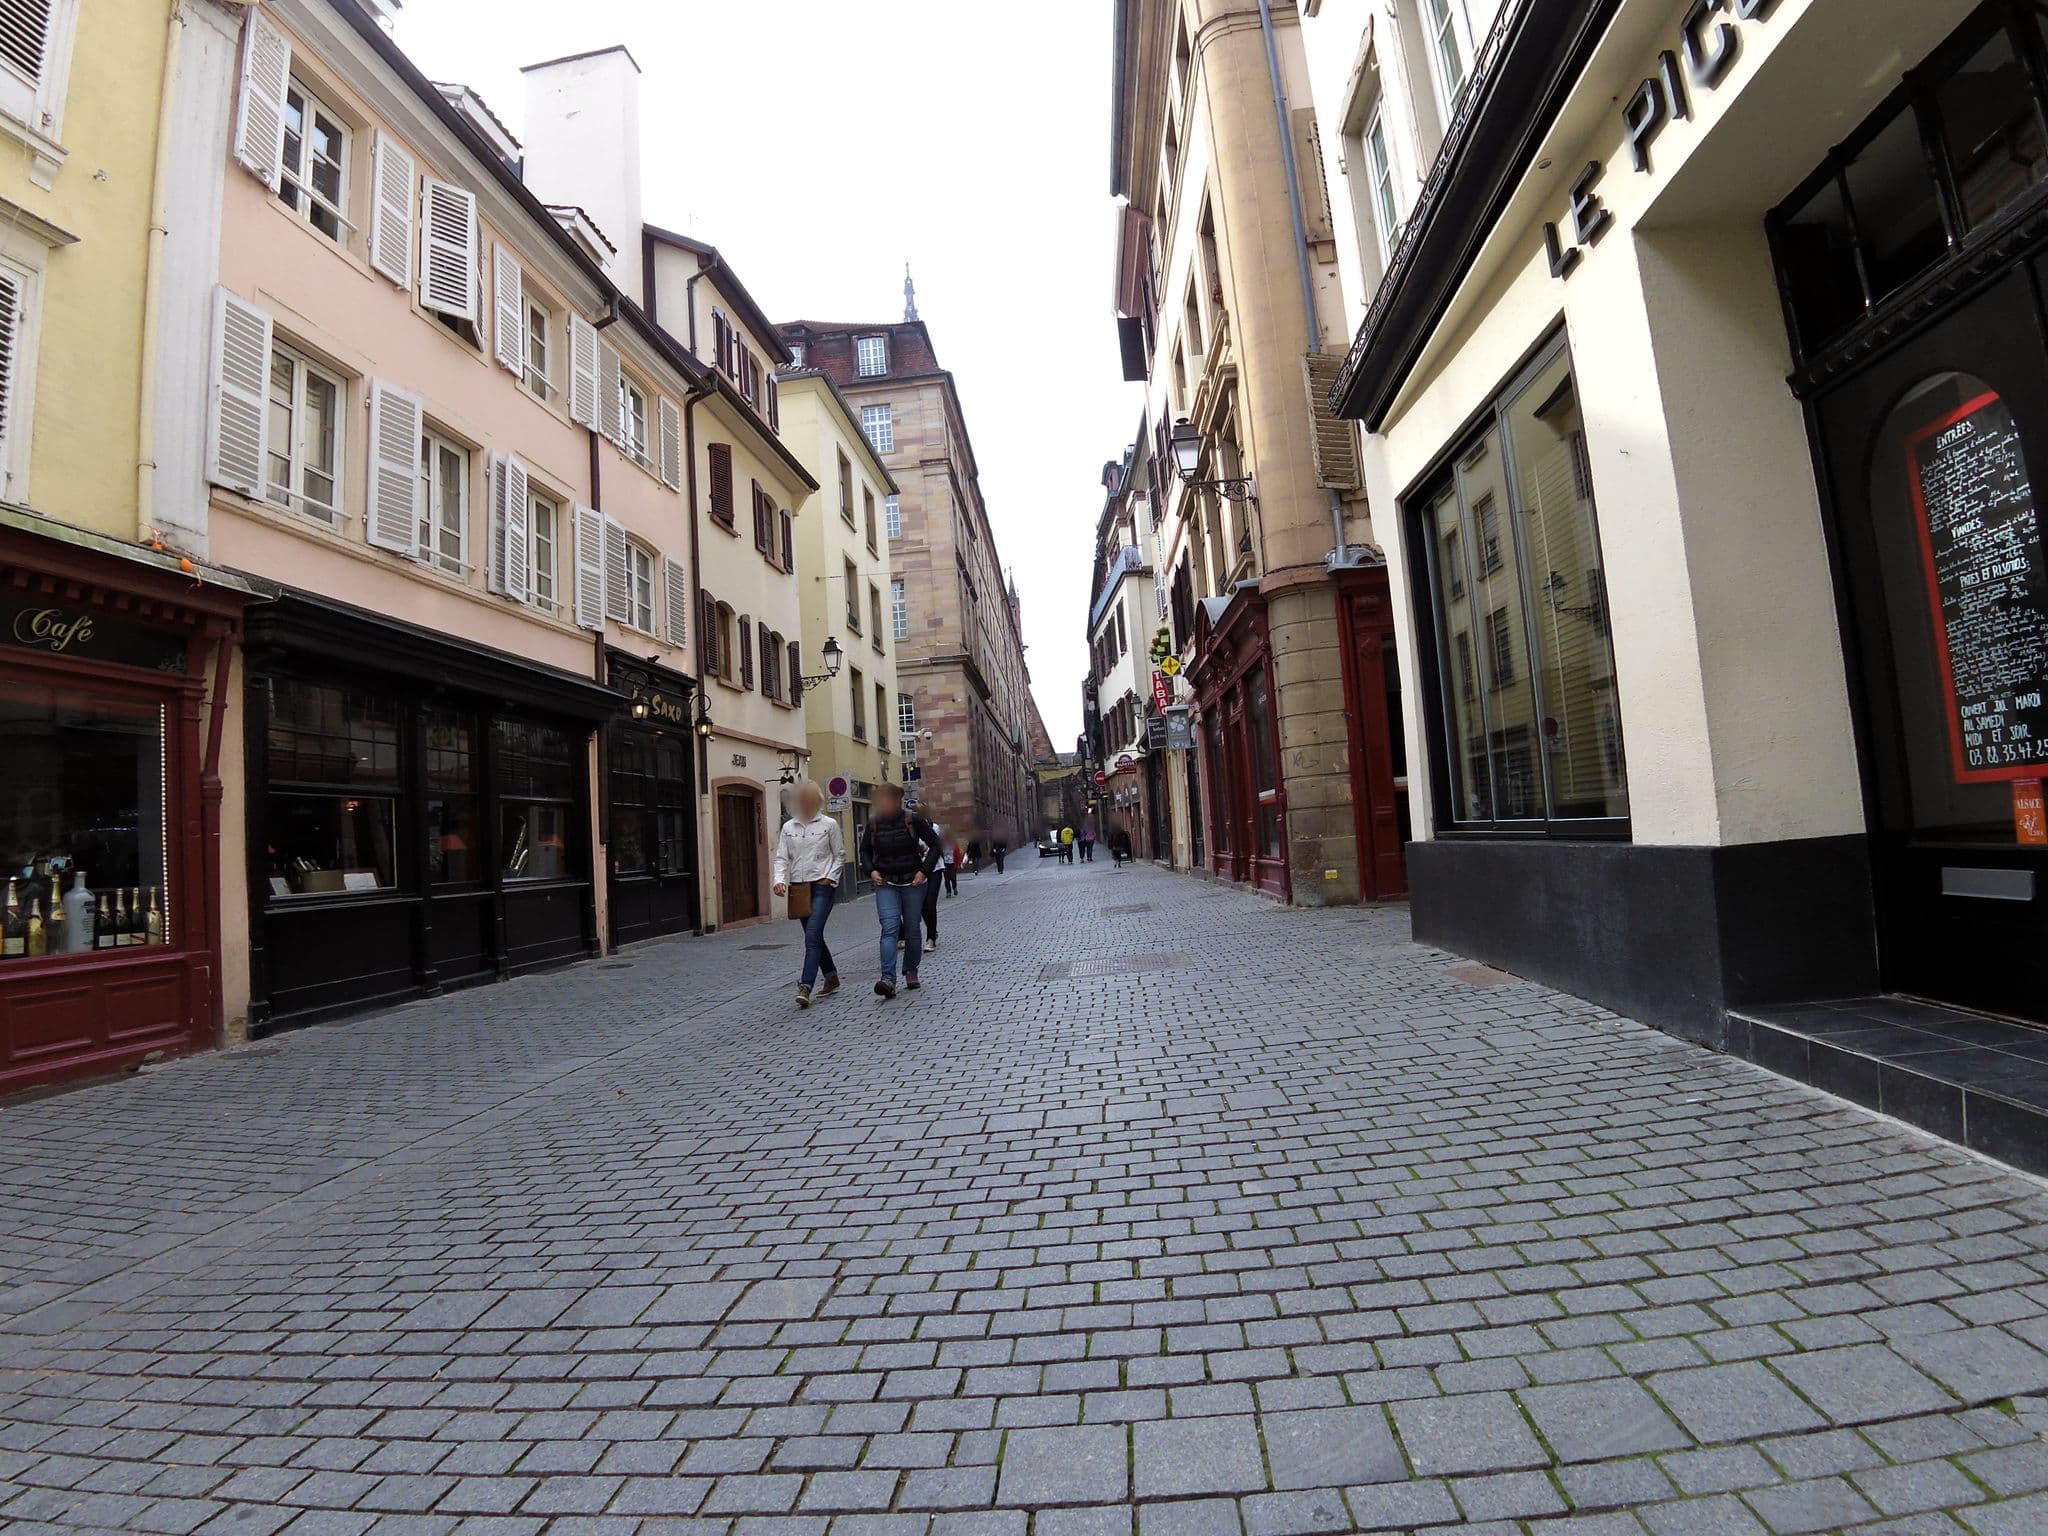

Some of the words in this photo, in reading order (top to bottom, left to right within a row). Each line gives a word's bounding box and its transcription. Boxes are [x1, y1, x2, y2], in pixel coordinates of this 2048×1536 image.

[1542, 161, 1611, 279] LE
[1622, 0, 1786, 174] PIC
[1981, 568, 1991, 580] ET
[13, 608, 95, 651] Café
[1153, 671, 1168, 716] TABAC
[1961, 702, 1987, 718] OUVERT
[1993, 700, 2008, 713] DU
[2015, 689, 2042, 710] MARDI
[1965, 733, 1983, 748] MIDI
[1992, 729, 2002, 742] ET
[2009, 721, 2032, 740] SOIR
[1976, 714, 2005, 730] SAMEDI
[2016, 799, 2042, 810] ALSACE
